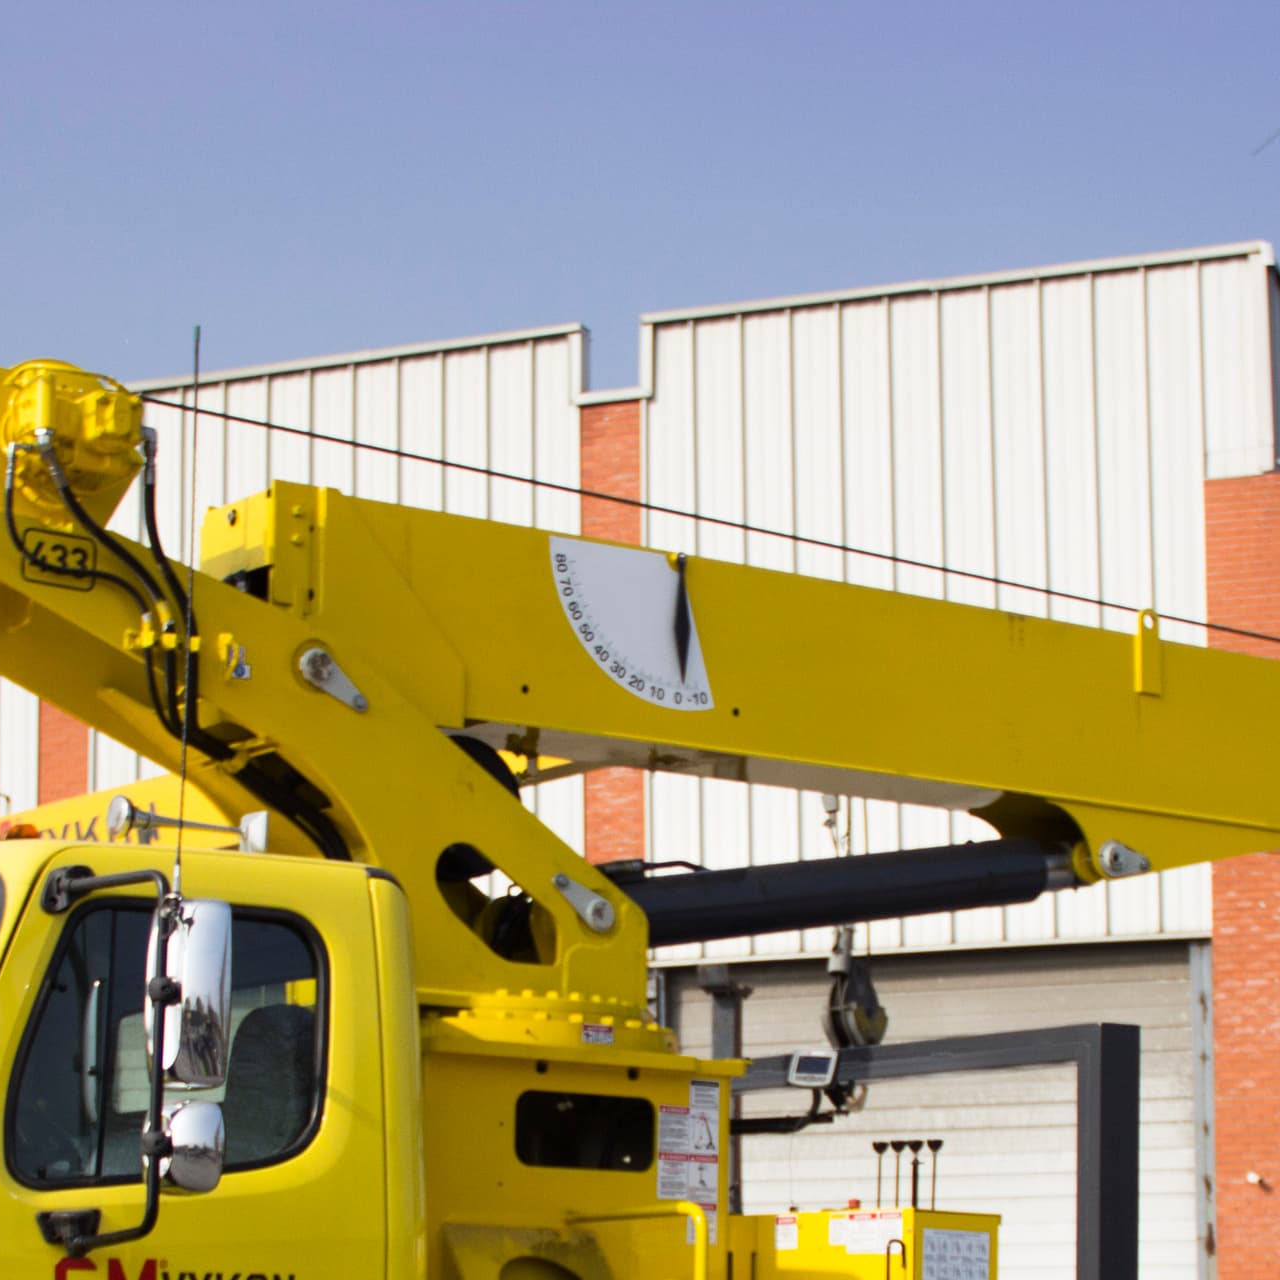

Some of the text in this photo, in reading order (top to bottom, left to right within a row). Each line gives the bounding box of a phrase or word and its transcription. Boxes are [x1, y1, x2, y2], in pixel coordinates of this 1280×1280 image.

[29, 541, 89, 579] 433
[555, 553, 569, 573] 80
[560, 578, 574, 597] 70
[568, 601, 583, 621] 60
[579, 623, 595, 642] 50
[593, 645, 610, 662] 40
[609, 661, 627, 679] 30
[628, 675, 645, 692] 20
[650, 685, 665, 701] 10
[673, 692, 683, 705] 0
